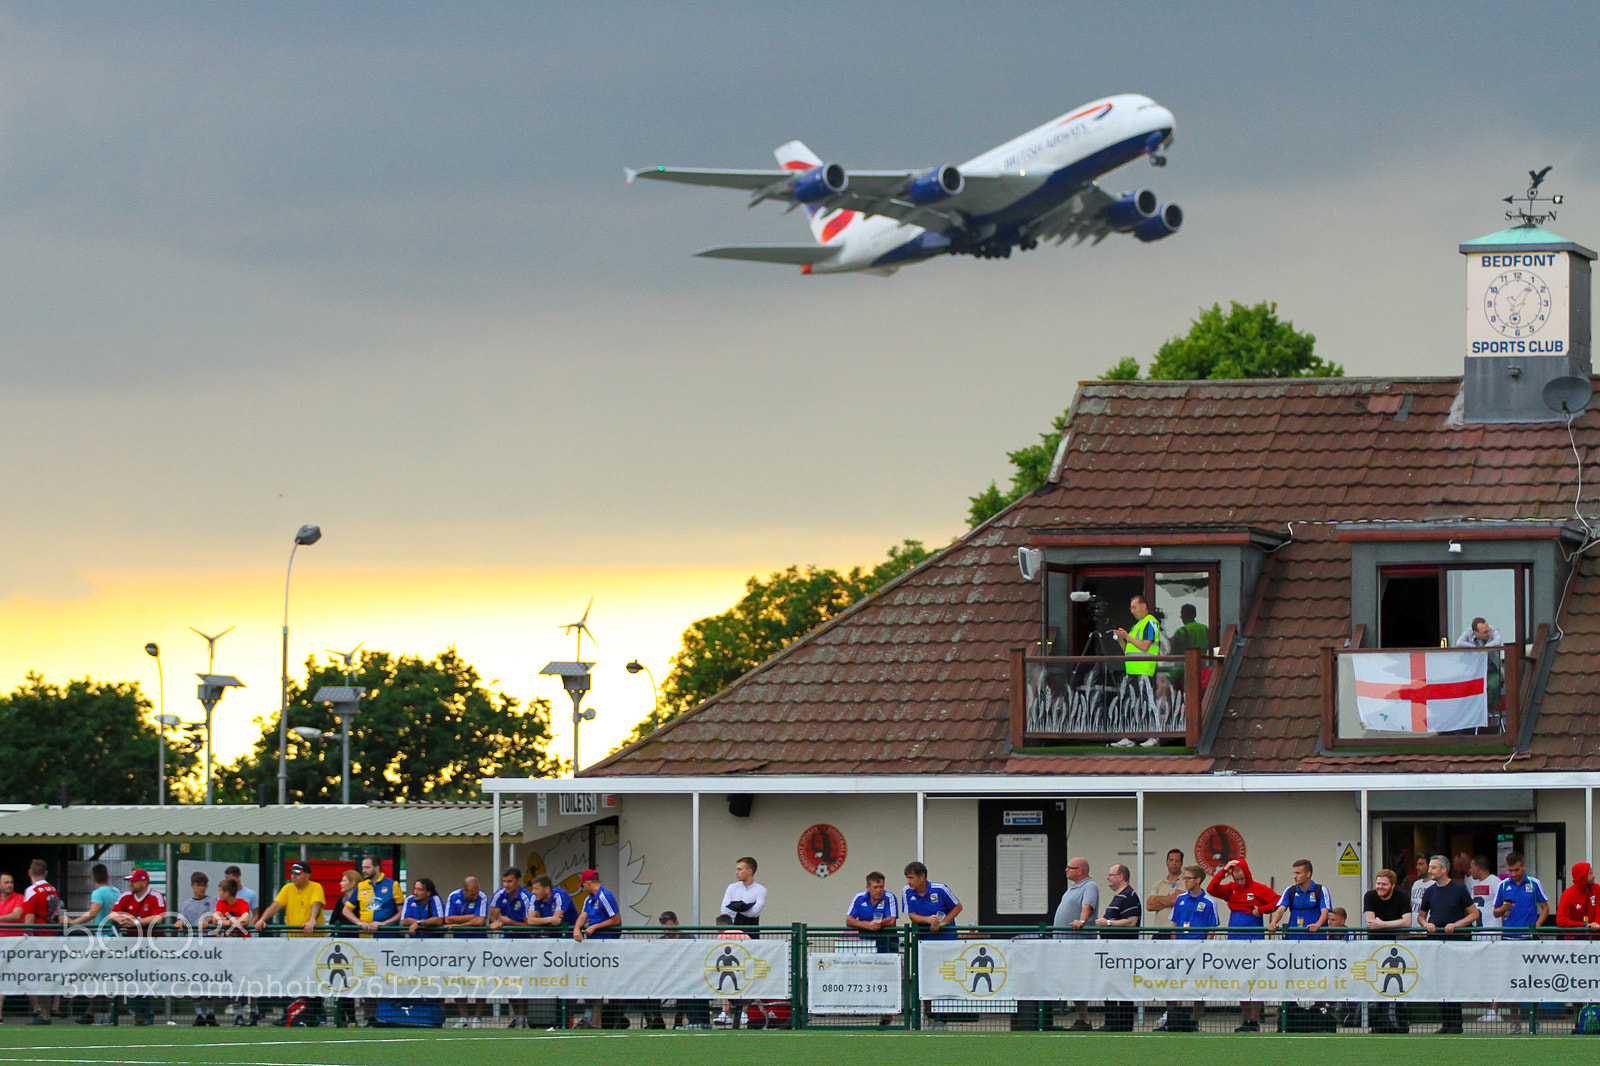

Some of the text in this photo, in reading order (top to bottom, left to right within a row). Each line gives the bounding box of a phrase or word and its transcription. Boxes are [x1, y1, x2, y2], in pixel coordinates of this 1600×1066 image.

[1481, 254, 1556, 268] BEDFONT
[1500, 275, 1508, 283] 11
[1513, 272, 1522, 280] 12
[1490, 286, 1498, 294] 10
[1501, 325, 1506, 333] 7
[1514, 329, 1521, 337] 6
[1528, 325, 1535, 333] 5
[1472, 340, 1564, 354] SPORTS CLUB
[381, 950, 620, 972] Temporary Power Solutions
[1095, 952, 1348, 974] Temporary Power Solutions
[0, 969, 233, 986] mporarypowersolutions.co.uk
[385, 972, 588, 990] Power when you need it
[822, 984, 888, 993] 0800 772 3193
[1132, 974, 1347, 993] Power when you need it
